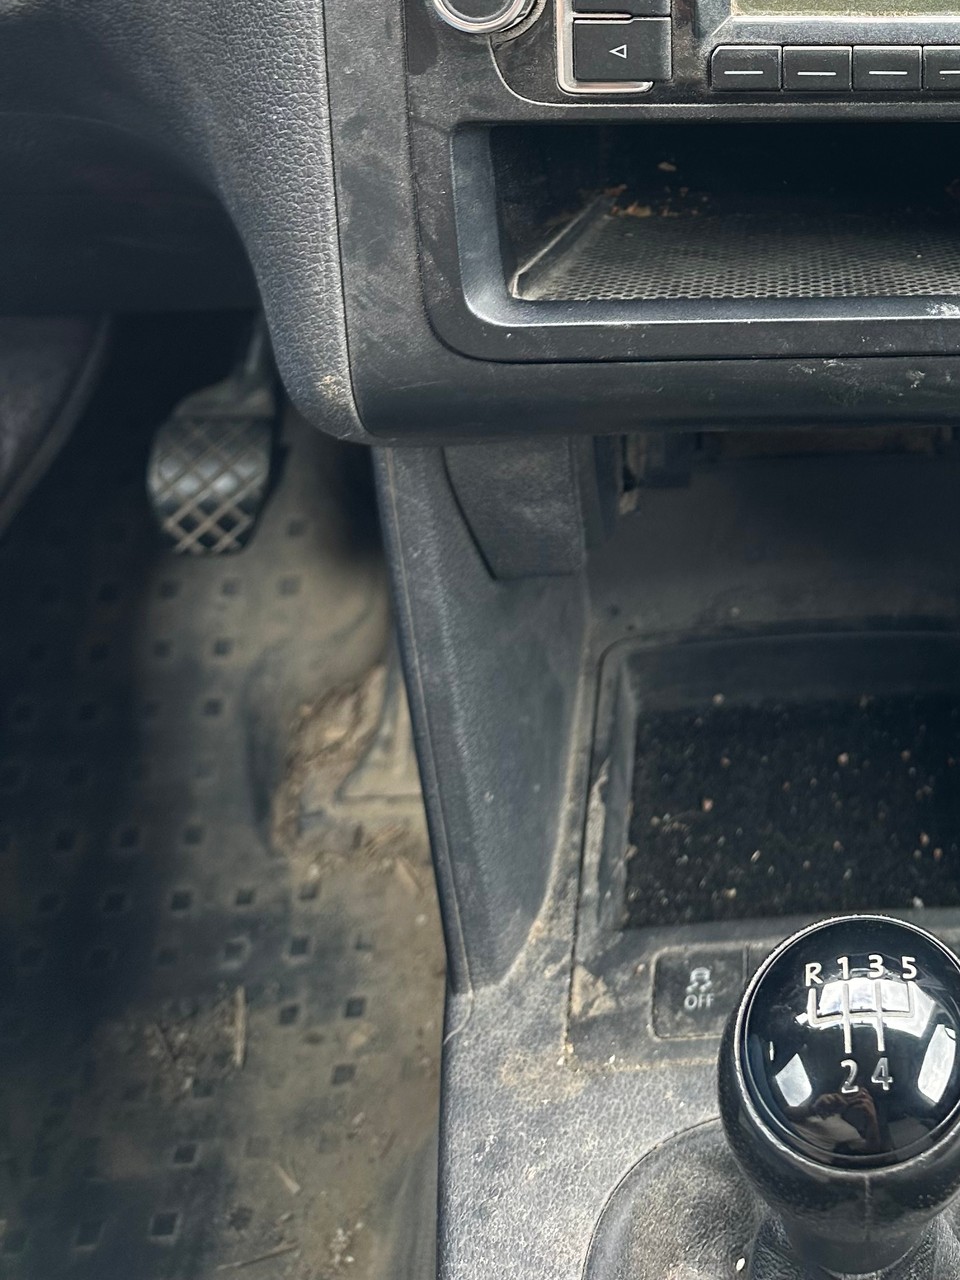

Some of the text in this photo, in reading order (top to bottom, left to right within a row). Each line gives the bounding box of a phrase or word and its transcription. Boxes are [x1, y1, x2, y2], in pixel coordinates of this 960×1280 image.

[805, 954, 918, 987] R 1 3 5
[684, 993, 715, 1010] OFF
[840, 1057, 893, 1094] 2 4
